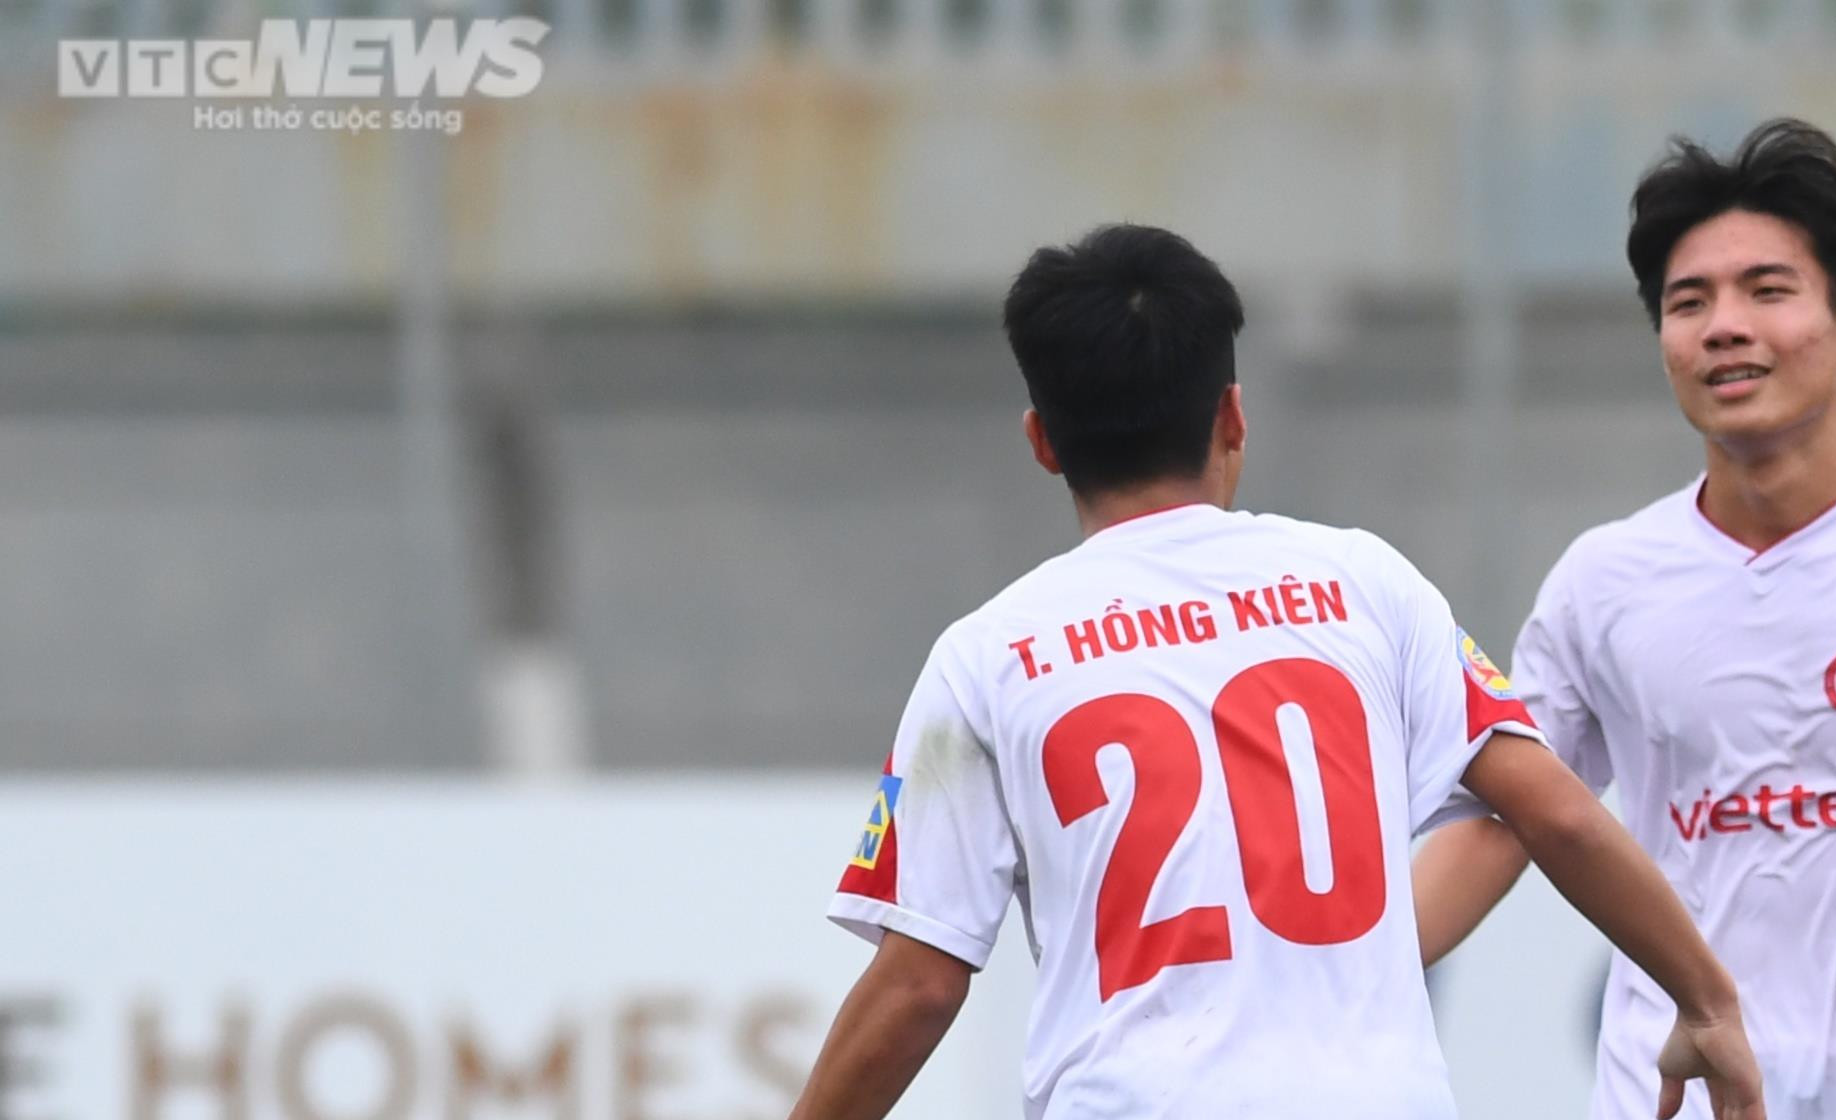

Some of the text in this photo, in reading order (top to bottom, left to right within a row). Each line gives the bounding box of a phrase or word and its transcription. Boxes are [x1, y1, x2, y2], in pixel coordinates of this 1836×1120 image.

[1008, 574, 1348, 681] T. HỒNG KIÊN
[1042, 657, 1386, 1004] 20
